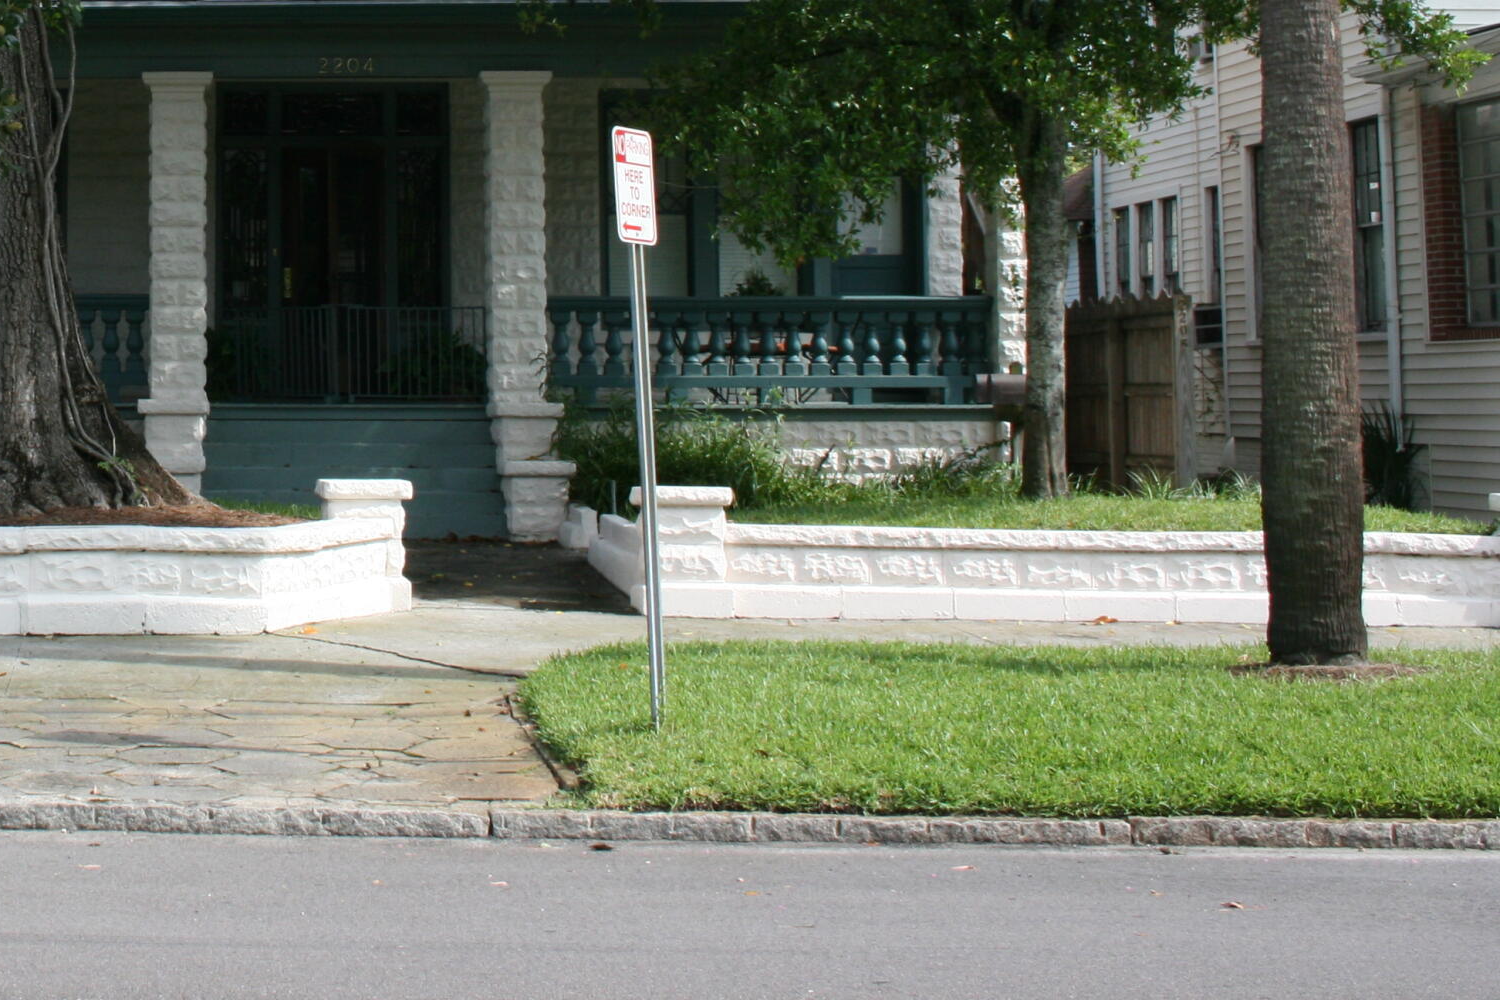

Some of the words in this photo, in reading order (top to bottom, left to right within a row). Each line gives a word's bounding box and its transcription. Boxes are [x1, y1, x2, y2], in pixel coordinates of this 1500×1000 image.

[318, 57, 373, 73] 2204
[615, 133, 626, 156] NO
[626, 139, 649, 156] PARKING
[624, 169, 644, 184] HERE
[629, 186, 640, 200] TO
[621, 202, 651, 218] CORNER
